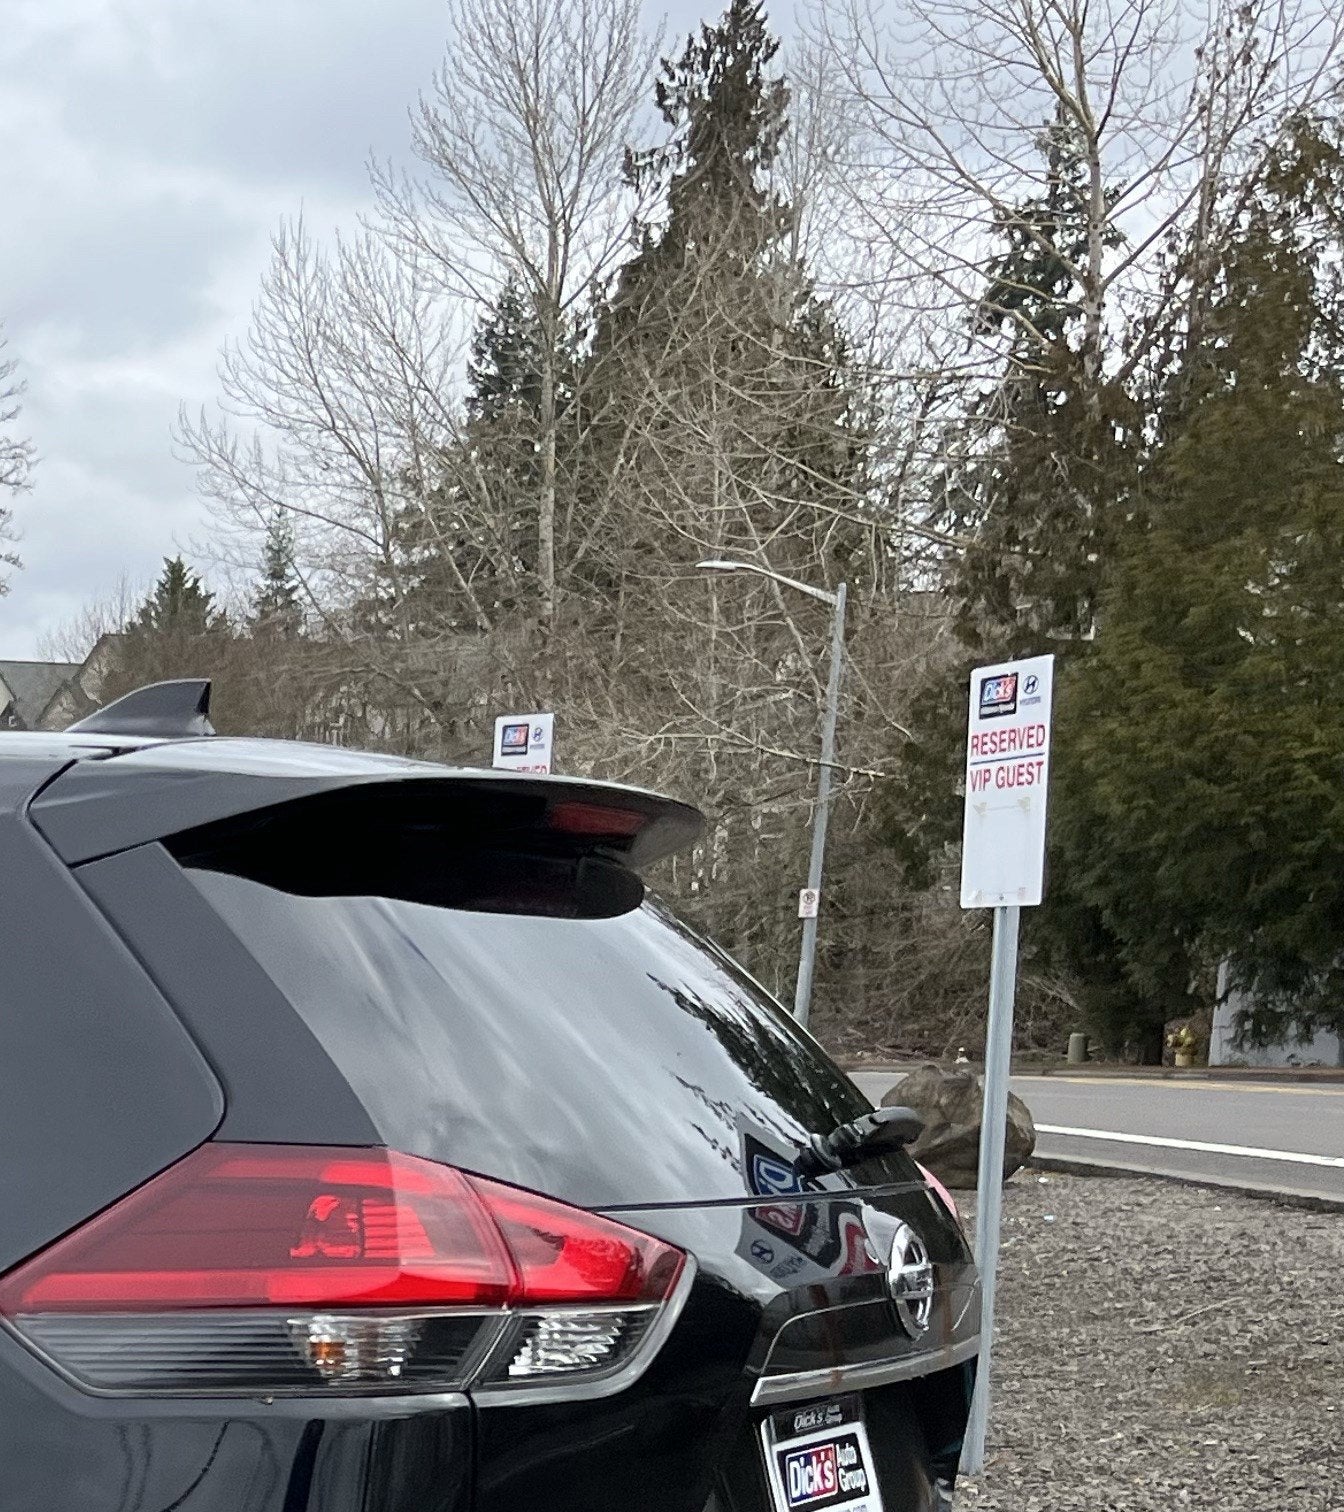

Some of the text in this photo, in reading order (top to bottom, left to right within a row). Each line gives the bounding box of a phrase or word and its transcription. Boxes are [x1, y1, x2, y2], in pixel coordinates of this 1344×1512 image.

[970, 724, 1046, 757] RESERVED
[970, 761, 1044, 792] VIP GUEST
[789, 1451, 834, 1498] Dick's
[838, 1467, 867, 1492] Group
